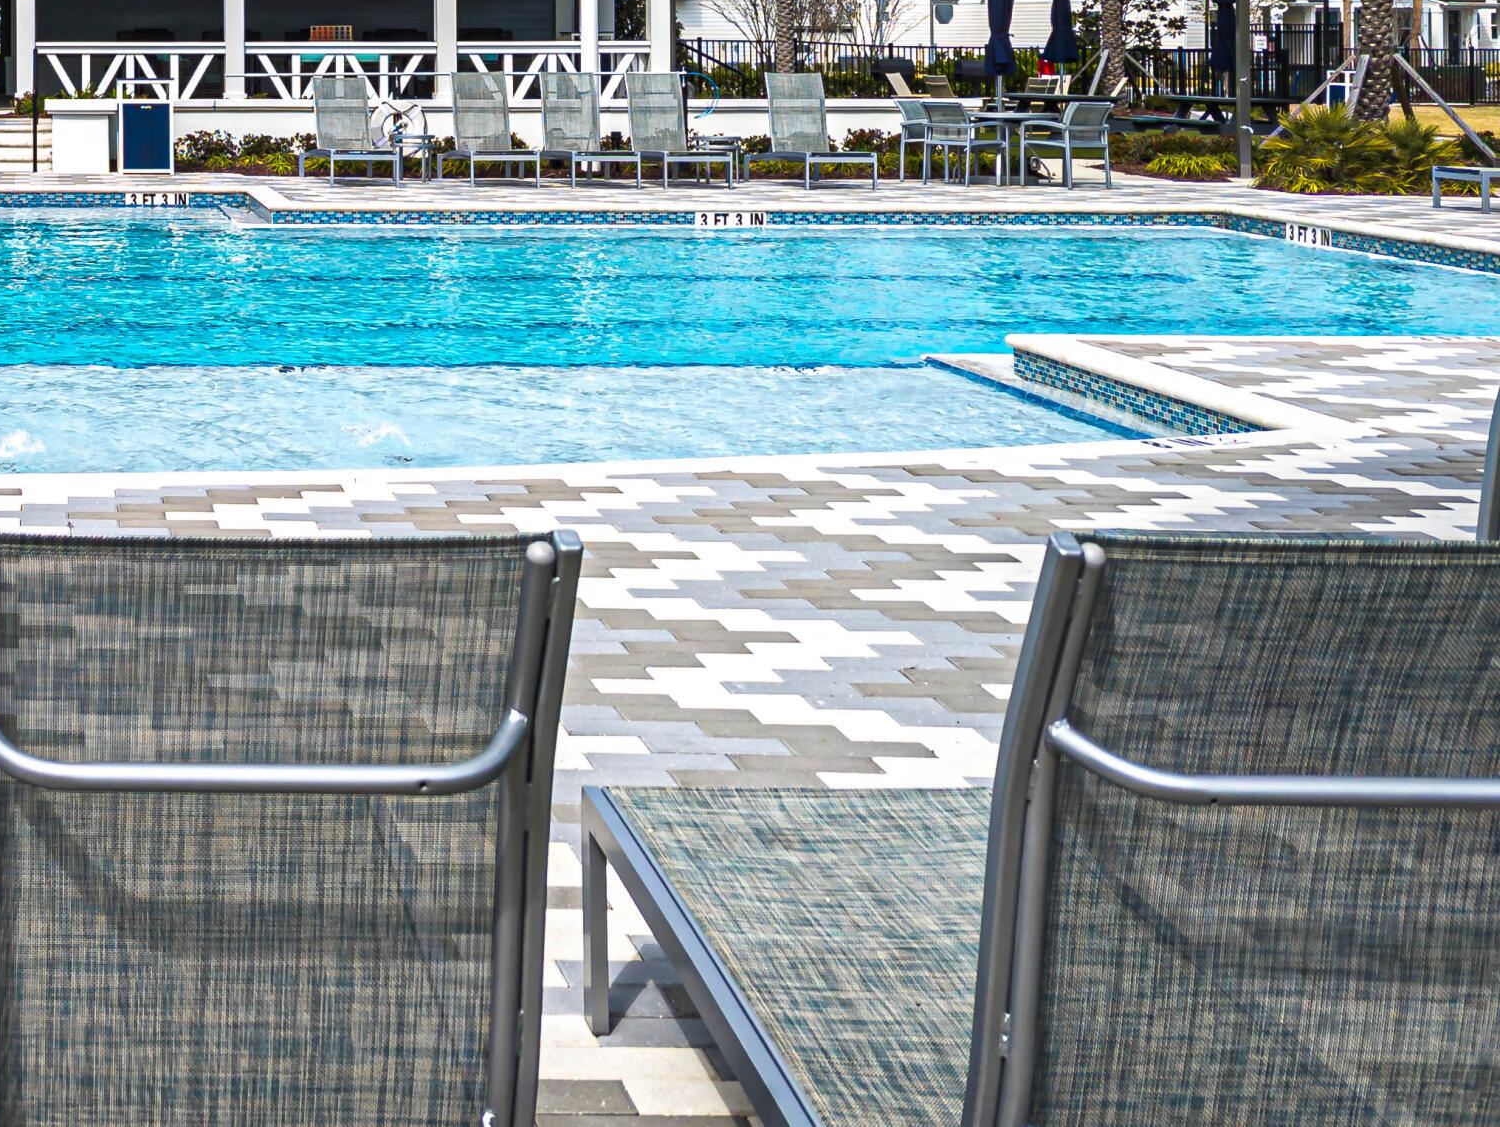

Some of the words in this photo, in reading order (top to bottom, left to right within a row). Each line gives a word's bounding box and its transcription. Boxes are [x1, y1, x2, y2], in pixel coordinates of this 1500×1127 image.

[143, 193, 156, 205] FT
[175, 193, 187, 205] IN
[714, 213, 729, 225] FT
[750, 213, 764, 225] IN
[1289, 224, 1295, 241] 3
[1298, 225, 1308, 243] FT
[1311, 228, 1317, 244] 3
[1320, 229, 1330, 247] IN
